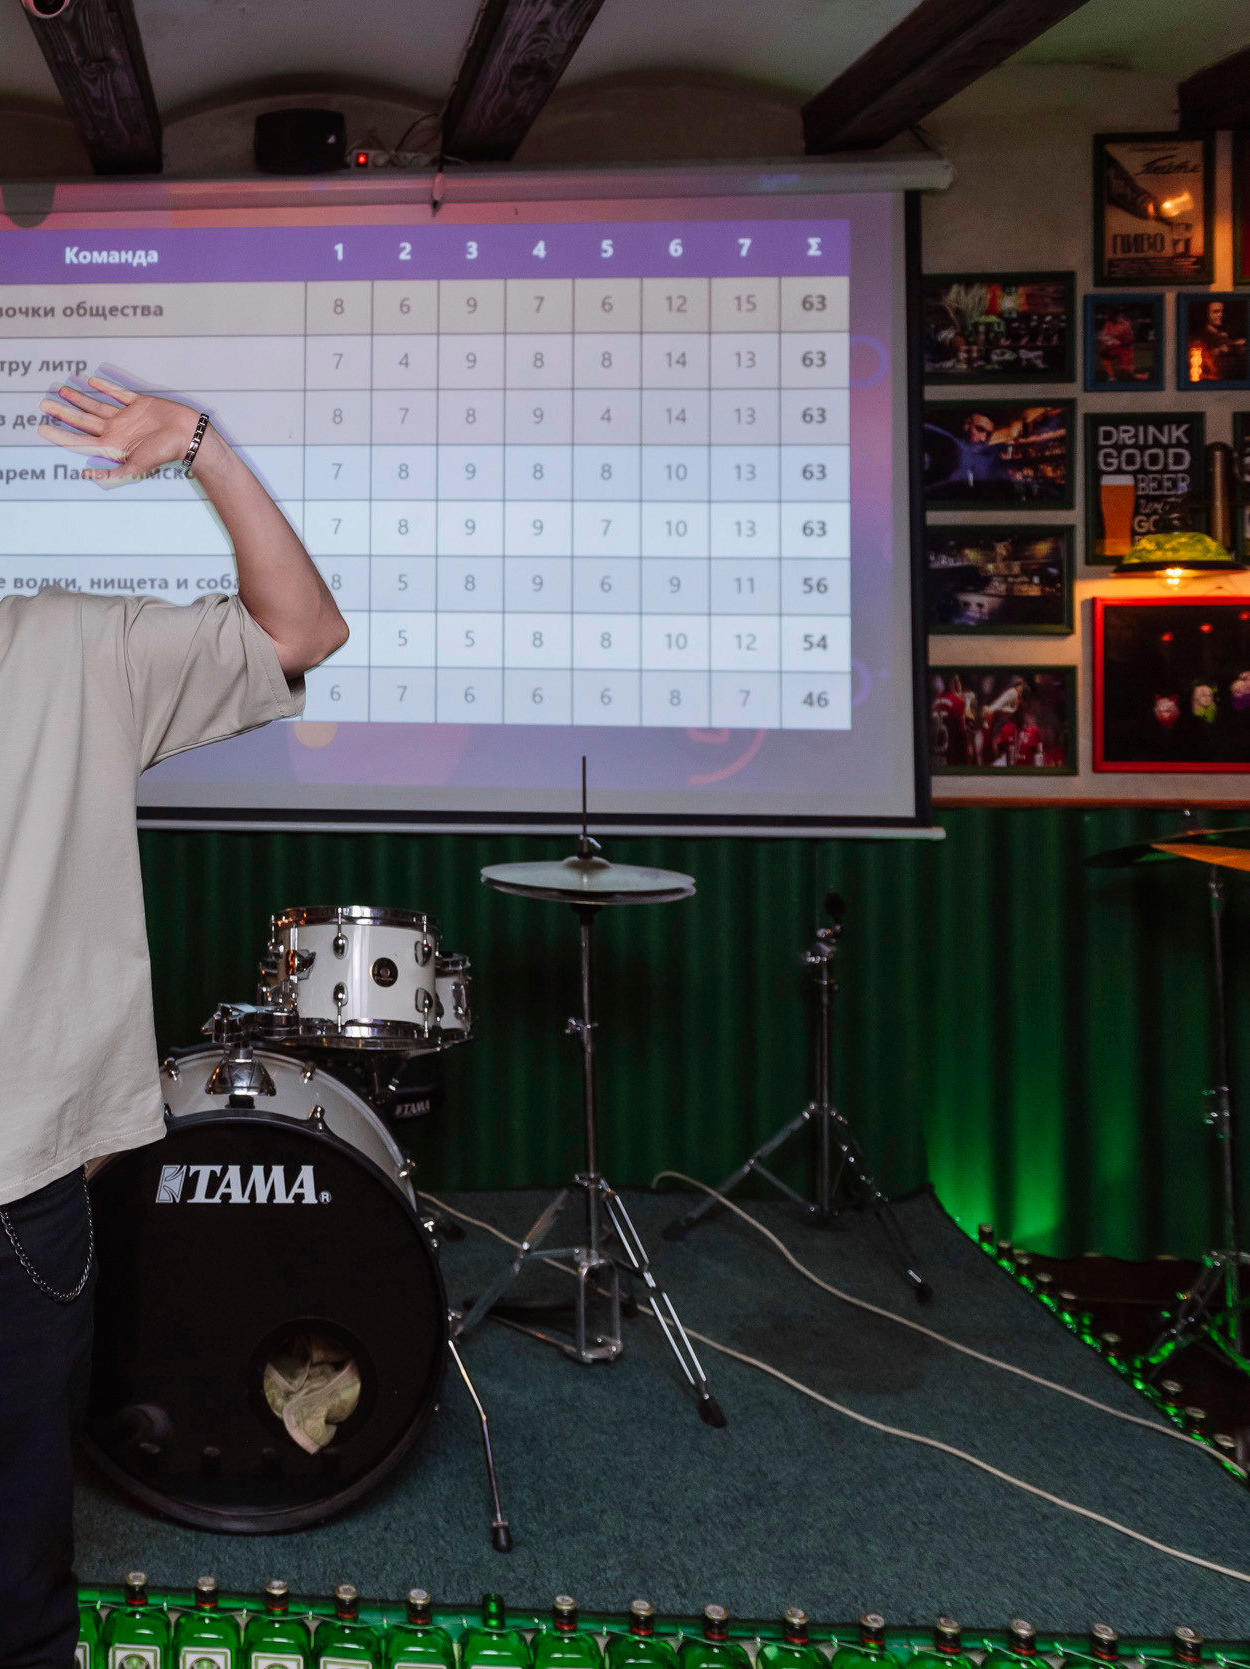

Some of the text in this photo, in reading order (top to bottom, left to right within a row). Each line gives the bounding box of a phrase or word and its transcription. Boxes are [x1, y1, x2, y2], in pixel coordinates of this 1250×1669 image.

[64, 245, 159, 267] Команда
[334, 242, 344, 261] 1
[398, 241, 412, 261] 2
[465, 240, 479, 260] 3
[532, 240, 547, 259] 4
[601, 239, 614, 259] 5
[668, 238, 684, 258] 6
[737, 237, 752, 257] 7
[1112, 232, 1165, 255] ПИВО
[62, 300, 165, 321] общества
[332, 297, 345, 316] 8
[398, 297, 412, 316] 6
[465, 296, 479, 315] 9
[533, 295, 546, 314] 7
[600, 294, 614, 314] 6
[665, 294, 688, 314] 12
[734, 293, 758, 313] 15
[801, 294, 827, 312] 63
[38, 358, 88, 376] литр
[332, 352, 344, 370] 7
[398, 352, 410, 369] 4
[465, 351, 478, 370] 9
[532, 351, 545, 370] 8
[600, 350, 614, 369] 8
[665, 351, 688, 368] 14
[734, 350, 757, 369] 13
[801, 350, 827, 369] 63
[331, 407, 344, 426] 8
[398, 406, 410, 425] 7
[464, 407, 478, 426] 8
[532, 406, 545, 425] 9
[599, 407, 613, 424] 4
[665, 407, 687, 424] 14
[734, 406, 757, 426] 13
[801, 406, 827, 425] 63
[1097, 424, 1191, 447] DRINK
[1097, 447, 1192, 473] GOOD
[331, 462, 343, 481] 7
[397, 462, 410, 481] 8
[464, 462, 477, 481] 9
[531, 462, 545, 481] 8
[599, 462, 613, 481] 8
[664, 463, 689, 482] 10
[734, 463, 757, 482] 13
[801, 463, 828, 481] 63
[1136, 473, 1191, 496] BEER
[331, 517, 343, 536] 7
[397, 518, 410, 536] 8
[464, 518, 477, 536] 9
[531, 518, 545, 537] 9
[600, 518, 613, 537] 7
[664, 519, 689, 538] 10
[734, 519, 757, 538] 13
[801, 520, 828, 538] 63
[90, 576, 169, 594] нищета
[176, 577, 188, 590] и
[330, 573, 342, 592] 8
[397, 573, 409, 592] 5
[463, 573, 477, 592] 8
[531, 574, 545, 593] 9
[599, 574, 613, 594] 6
[668, 575, 682, 595] 9
[734, 576, 755, 595] 11
[802, 576, 829, 595] 56
[397, 629, 829, 652] 5 5 8 8 10 12 54
[329, 684, 829, 709] 6 7 6 6 6 8 7 46
[186, 1165, 319, 1204] TAMA
